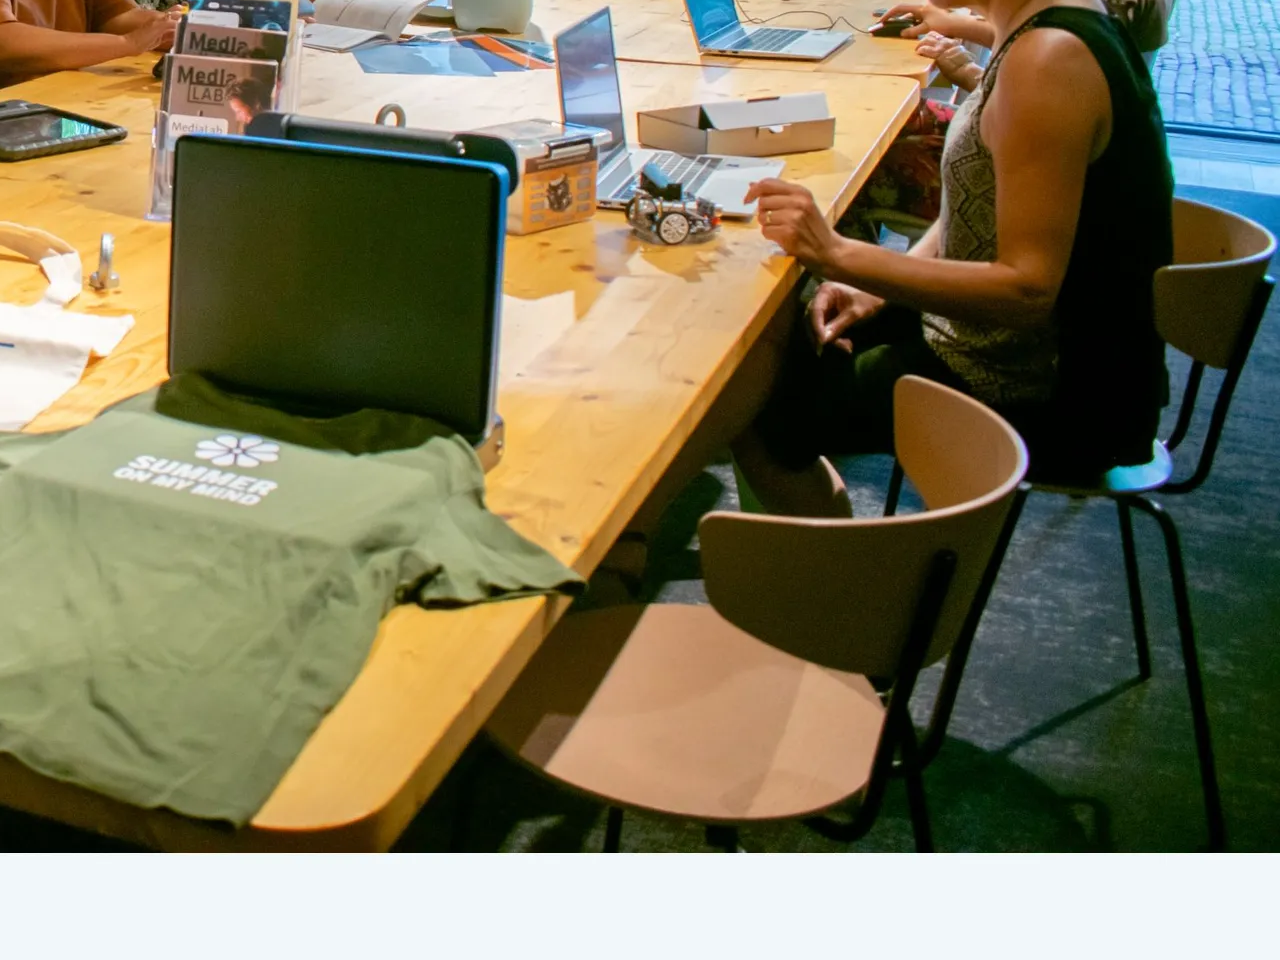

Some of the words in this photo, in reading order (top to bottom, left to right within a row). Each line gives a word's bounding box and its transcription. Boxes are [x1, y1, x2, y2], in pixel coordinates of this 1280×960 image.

[192, 86, 224, 102] LAB
[113, 467, 154, 482] ON
[151, 474, 195, 491] MY
[190, 483, 262, 506] MIND
[128, 455, 278, 496] SUMMER
